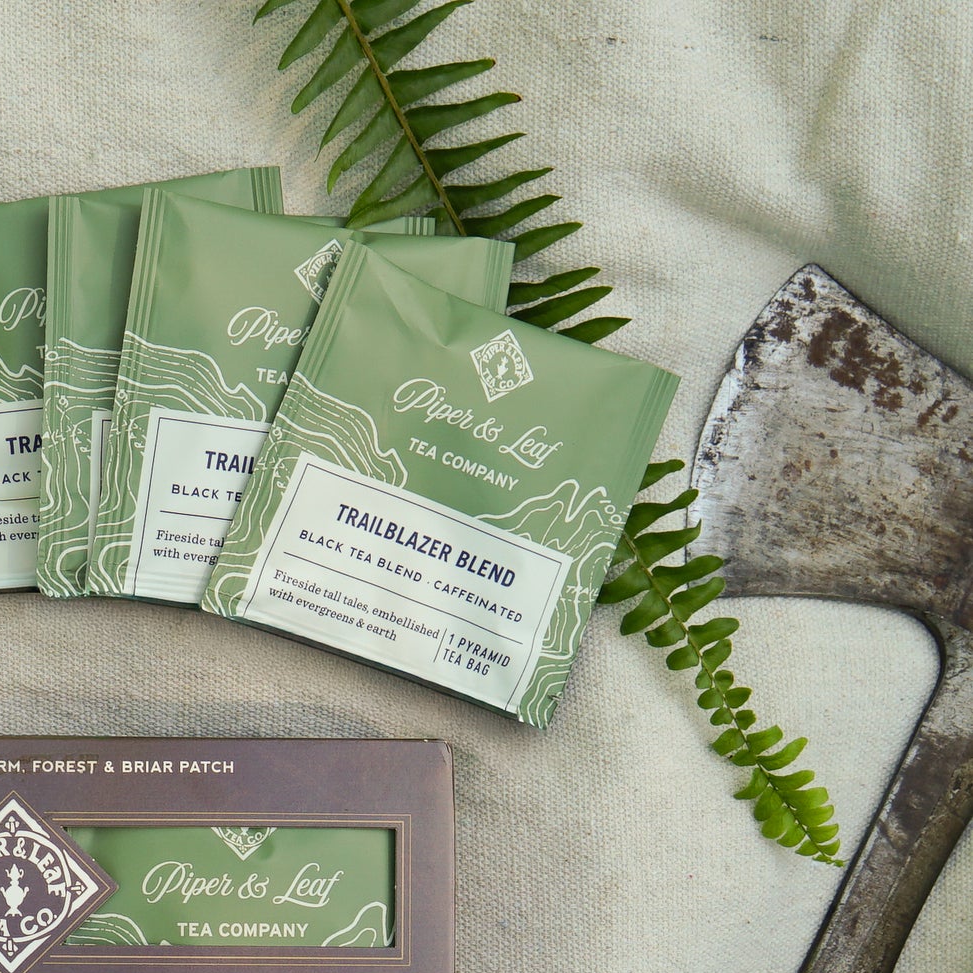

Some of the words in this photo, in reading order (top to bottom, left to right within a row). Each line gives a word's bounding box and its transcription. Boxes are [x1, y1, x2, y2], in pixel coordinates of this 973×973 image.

[393, 378, 474, 429] Piper
[473, 419, 504, 442] &
[499, 425, 563, 469] Leaf
[409, 437, 436, 458] TEA
[442, 451, 519, 491] COMPANY
[336, 504, 453, 563] TRAILBLAZER
[455, 549, 516, 588] BLEND
[299, 529, 343, 553] BLACK
[350, 547, 372, 563] TEA
[377, 557, 422, 582] BLEND
[433, 580, 523, 623] CAFFEINATED
[268, 586, 293, 603] with
[295, 597, 354, 626] evergreens
[356, 618, 364, 629] &
[366, 622, 397, 641] earth
[274, 569, 322, 596] Fireside
[323, 585, 341, 603] tall
[343, 593, 369, 612] tales,
[371, 605, 440, 639] embellished
[443, 649, 462, 665] TEA
[467, 657, 490, 676] BAG
[449, 634, 455, 645] 1
[458, 637, 510, 668] PYRAMID
[32, 760, 97, 774] FOREST
[104, 761, 114, 773] &
[122, 760, 173, 774] BRIAR
[179, 761, 234, 773] PATCH
[13, 838, 28, 858] &
[20, 907, 58, 934] CO.
[177, 922, 212, 937] TEA
[218, 922, 309, 938] COMPANY
